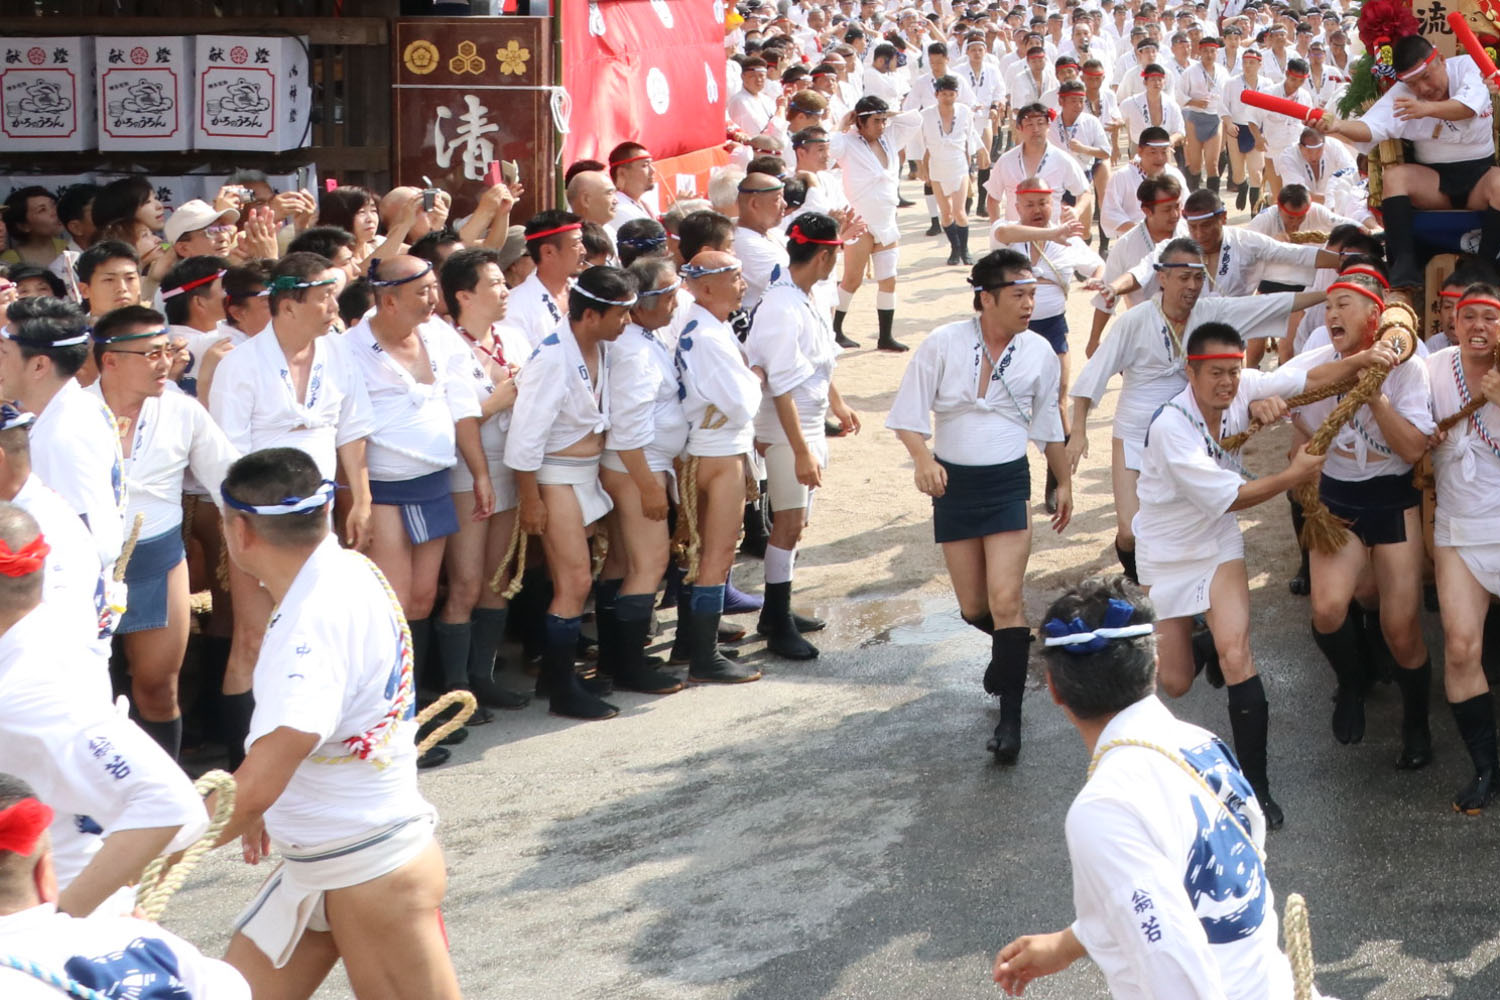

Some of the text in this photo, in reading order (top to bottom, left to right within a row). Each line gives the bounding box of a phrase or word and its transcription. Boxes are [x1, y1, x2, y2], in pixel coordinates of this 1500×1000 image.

[211, 115, 263, 128] かろのうろん
[434, 94, 500, 182] 清
[1131, 888, 1163, 944] 翁若
